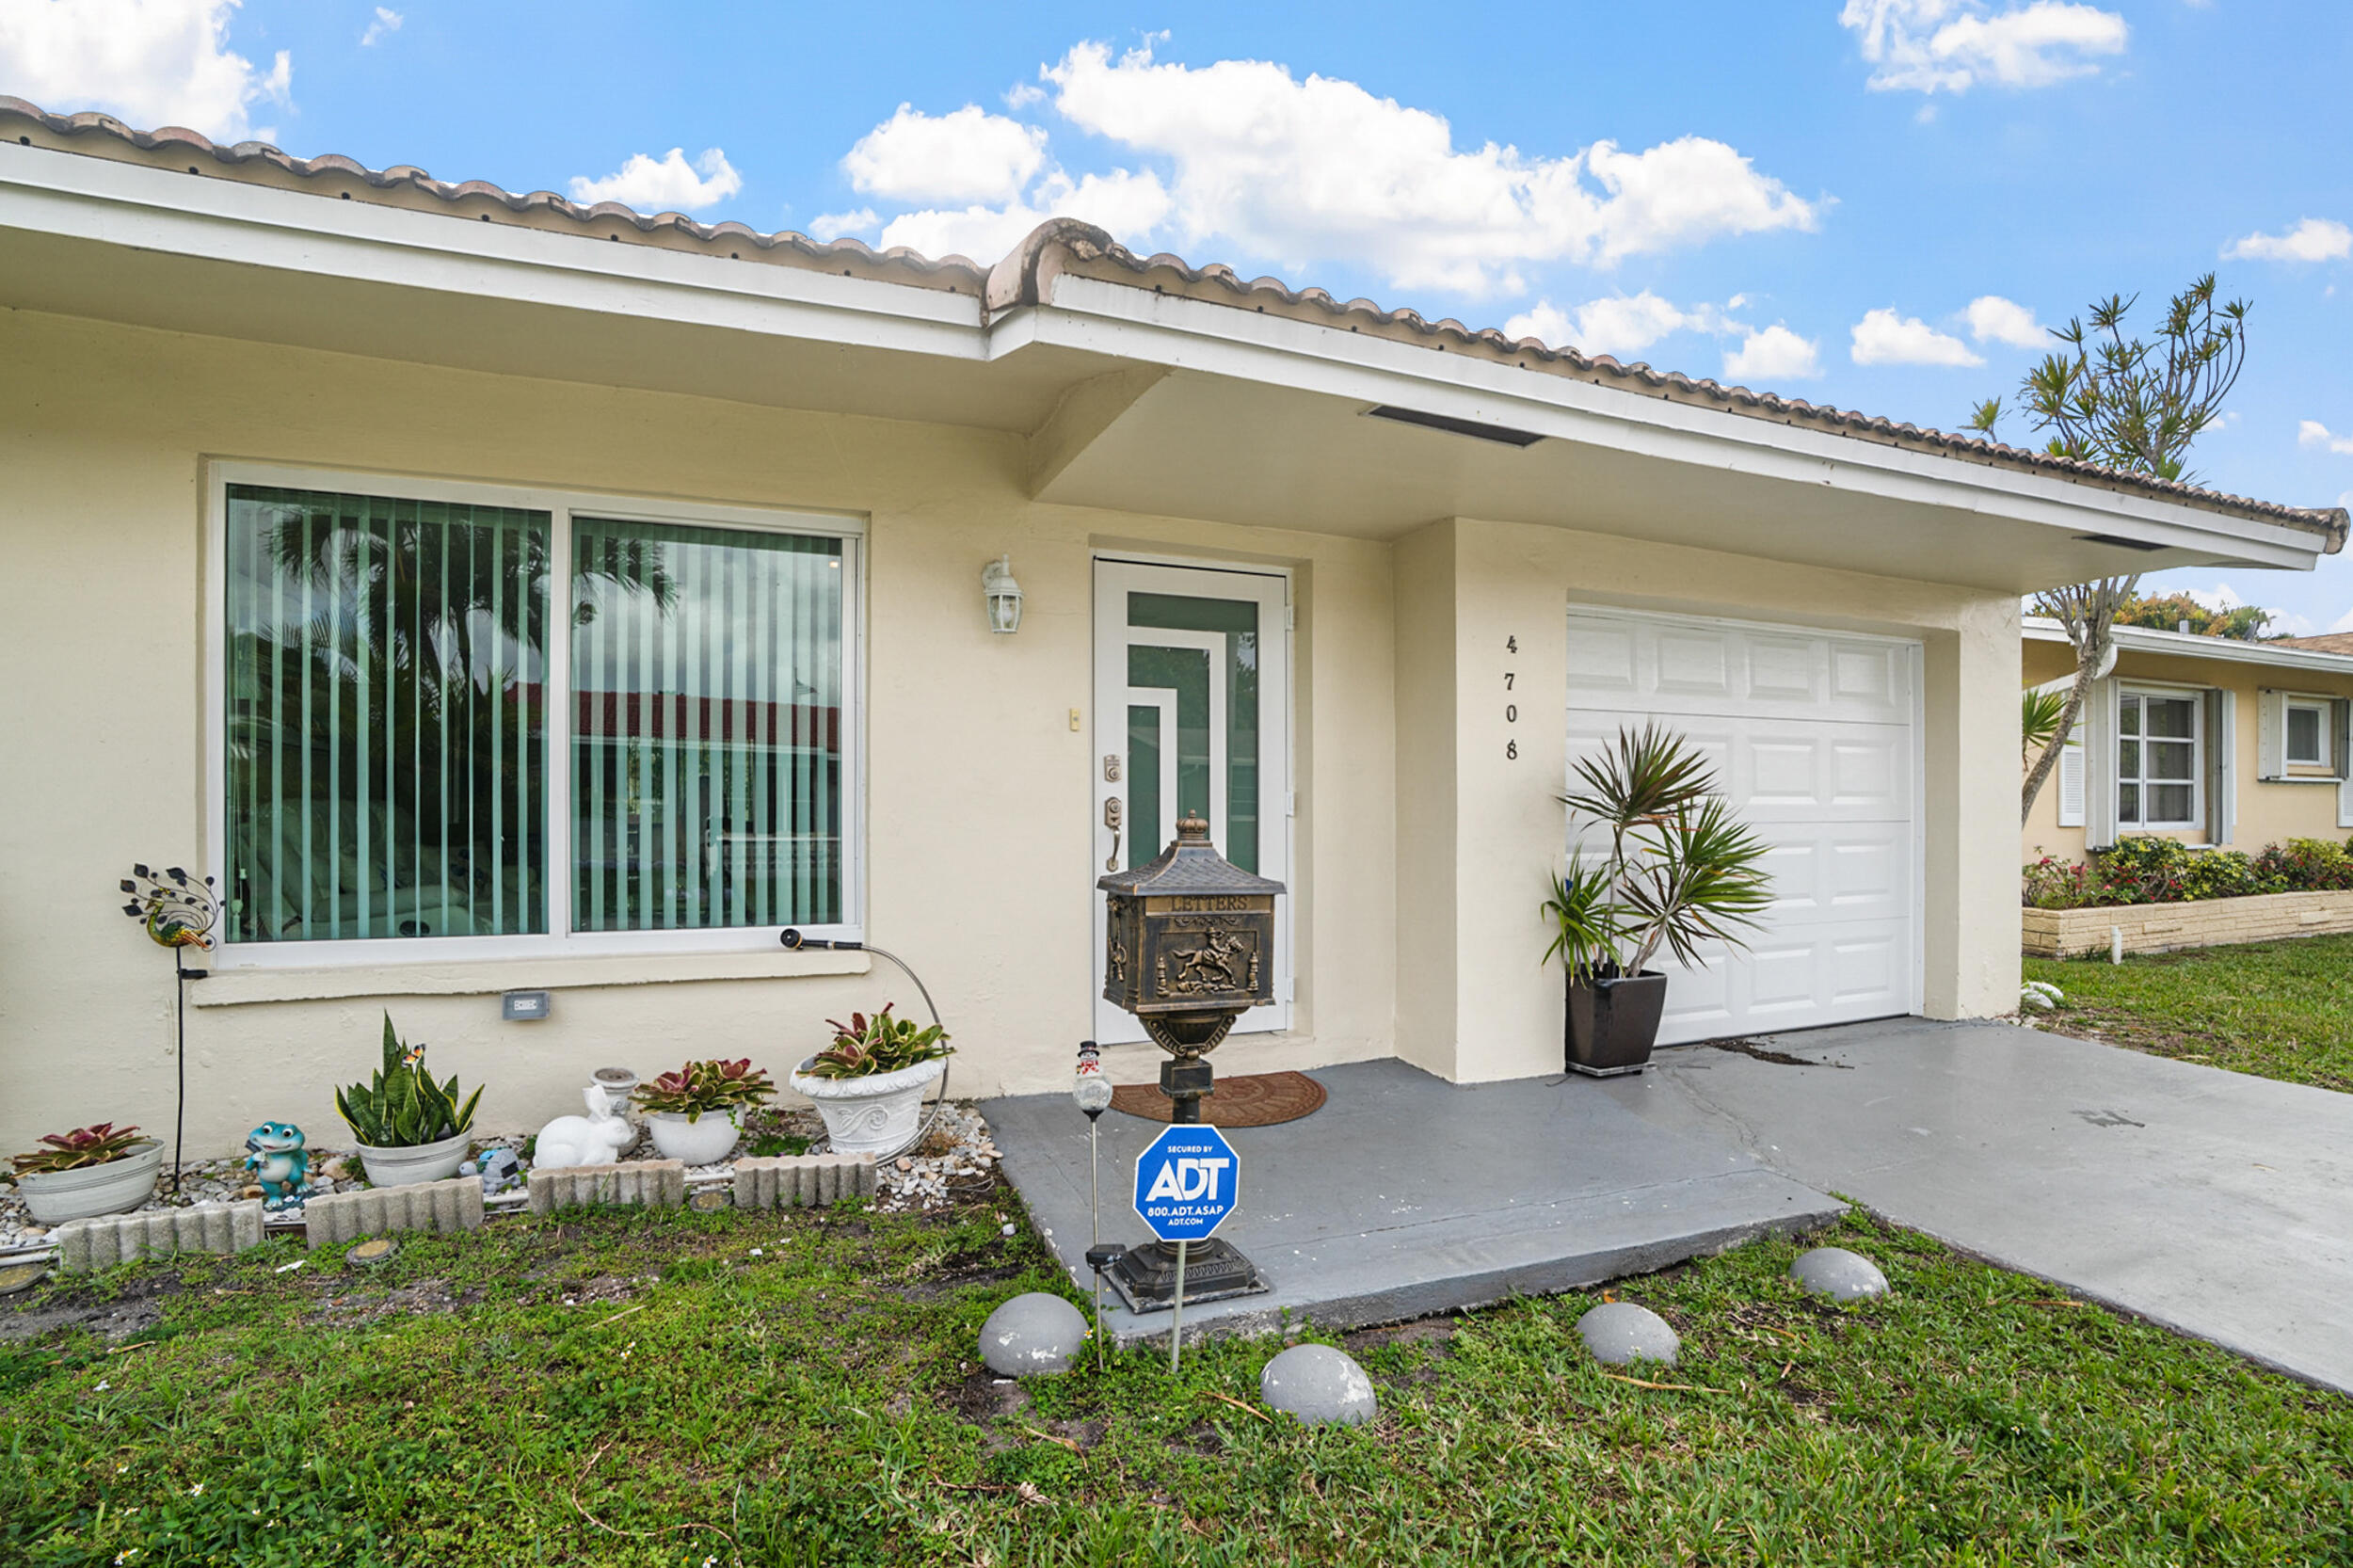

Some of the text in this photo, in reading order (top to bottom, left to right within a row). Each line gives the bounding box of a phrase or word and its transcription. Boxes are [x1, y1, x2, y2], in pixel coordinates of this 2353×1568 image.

[1504, 634, 1518, 760] 4708
[1171, 895, 1249, 912] LETTERS
[1167, 1145, 1202, 1154] SECURED
[1144, 1158, 1230, 1202] ADT
[1147, 1205, 1224, 1217] 800.ADT.ASAP
[1167, 1218, 1204, 1226] ADT.COM
